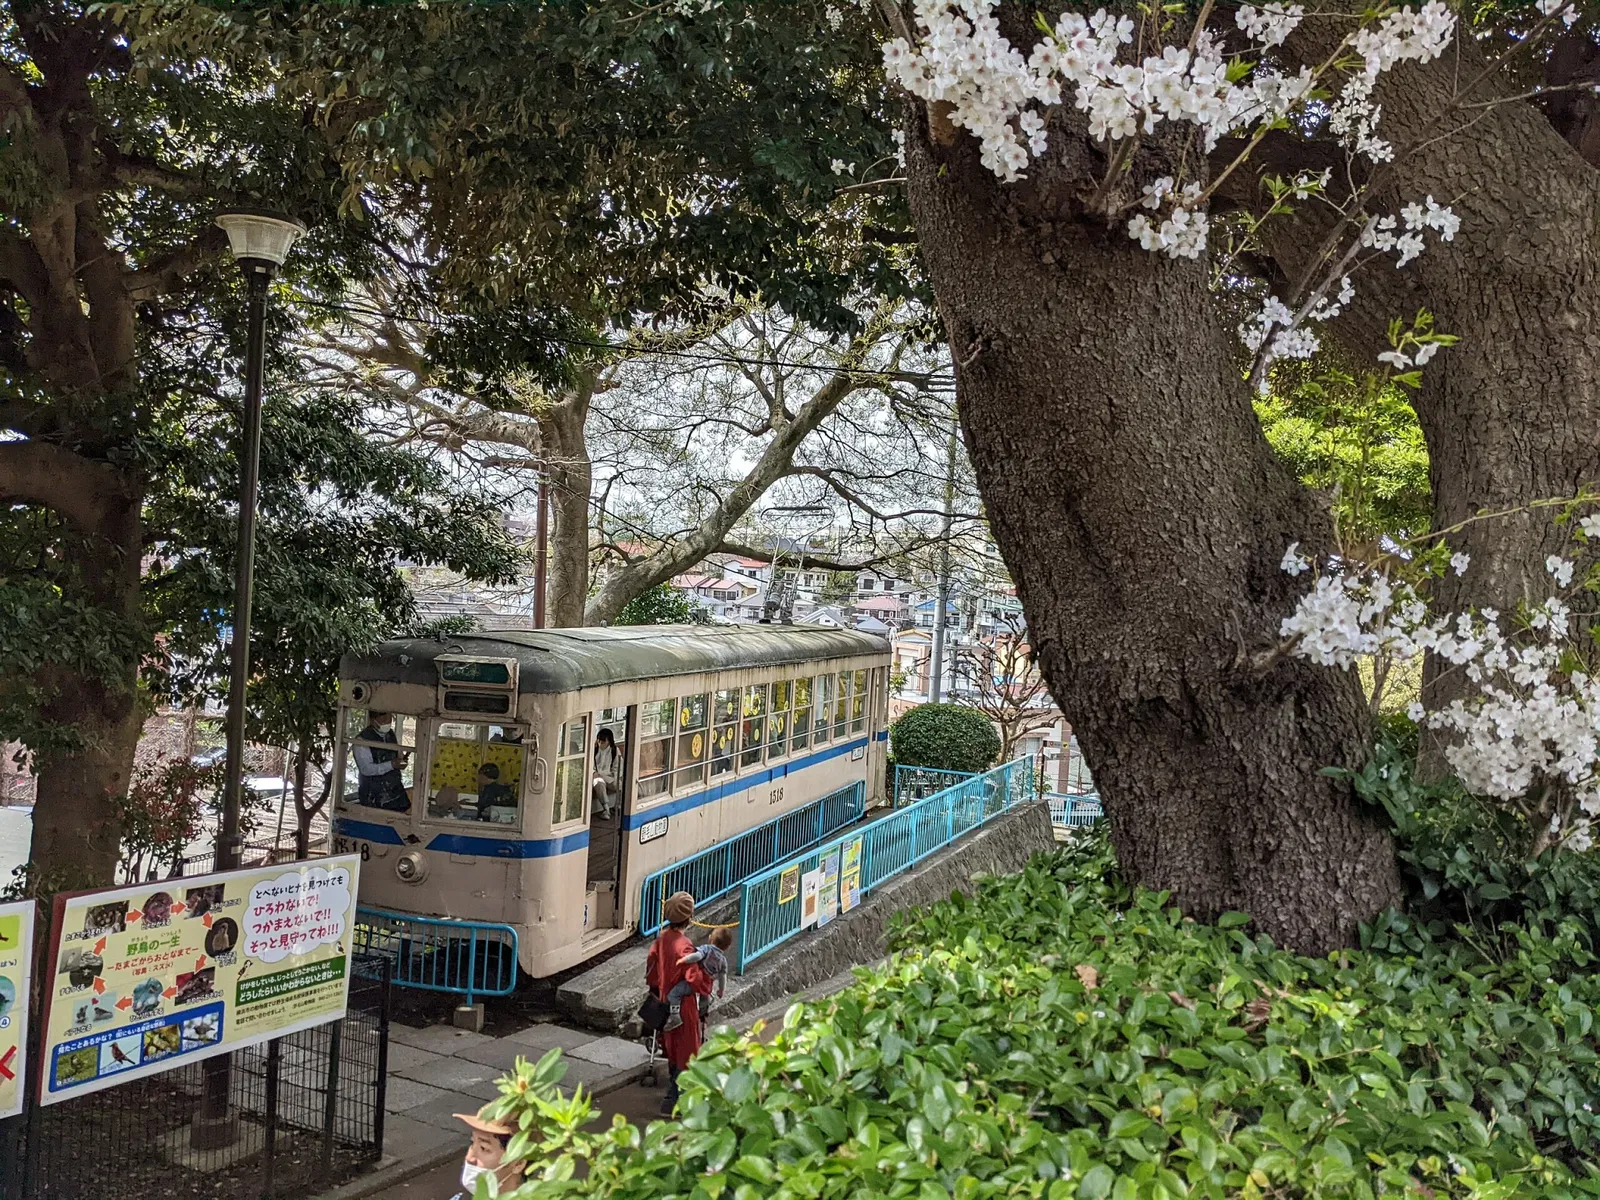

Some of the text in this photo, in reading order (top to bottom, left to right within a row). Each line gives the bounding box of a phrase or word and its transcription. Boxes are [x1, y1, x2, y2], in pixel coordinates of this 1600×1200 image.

[769, 787, 784, 806] 1518
[255, 875, 343, 899] とべないヒナを見つけても
